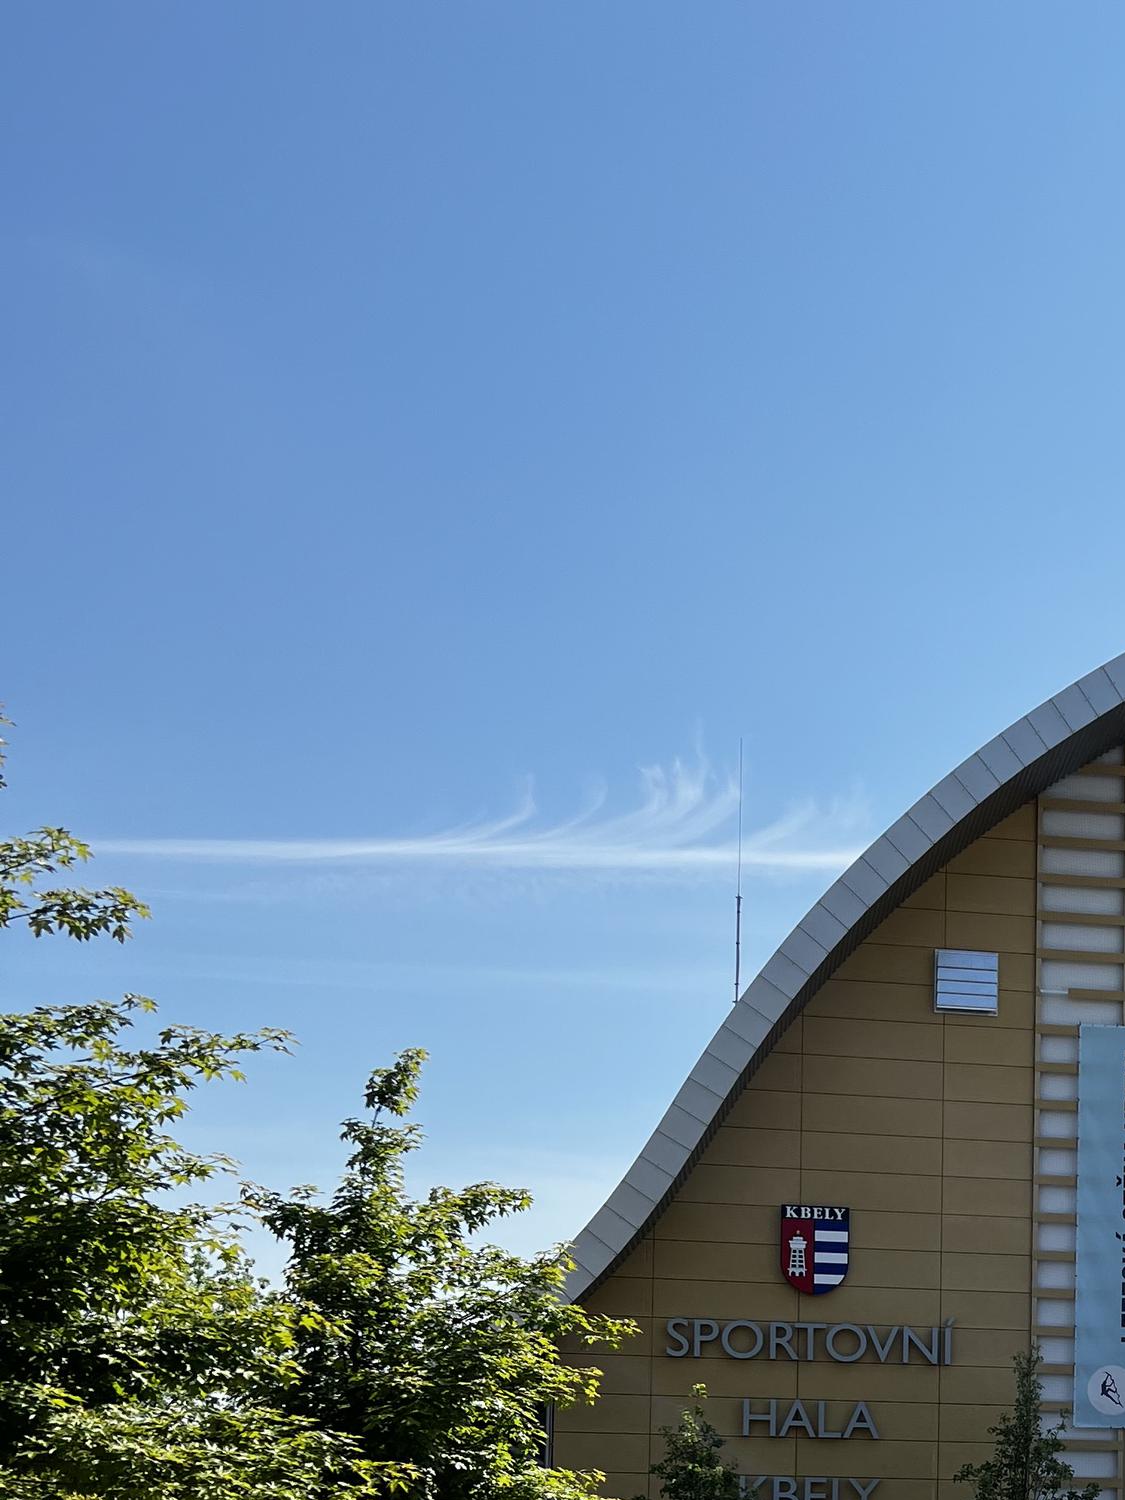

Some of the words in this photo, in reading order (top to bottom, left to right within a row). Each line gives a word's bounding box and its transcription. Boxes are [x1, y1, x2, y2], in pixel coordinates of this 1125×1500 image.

[784, 1205, 847, 1221] KBELY
[665, 1317, 955, 1366] SPORTOVNÍ
[742, 1398, 880, 1440] HALA
